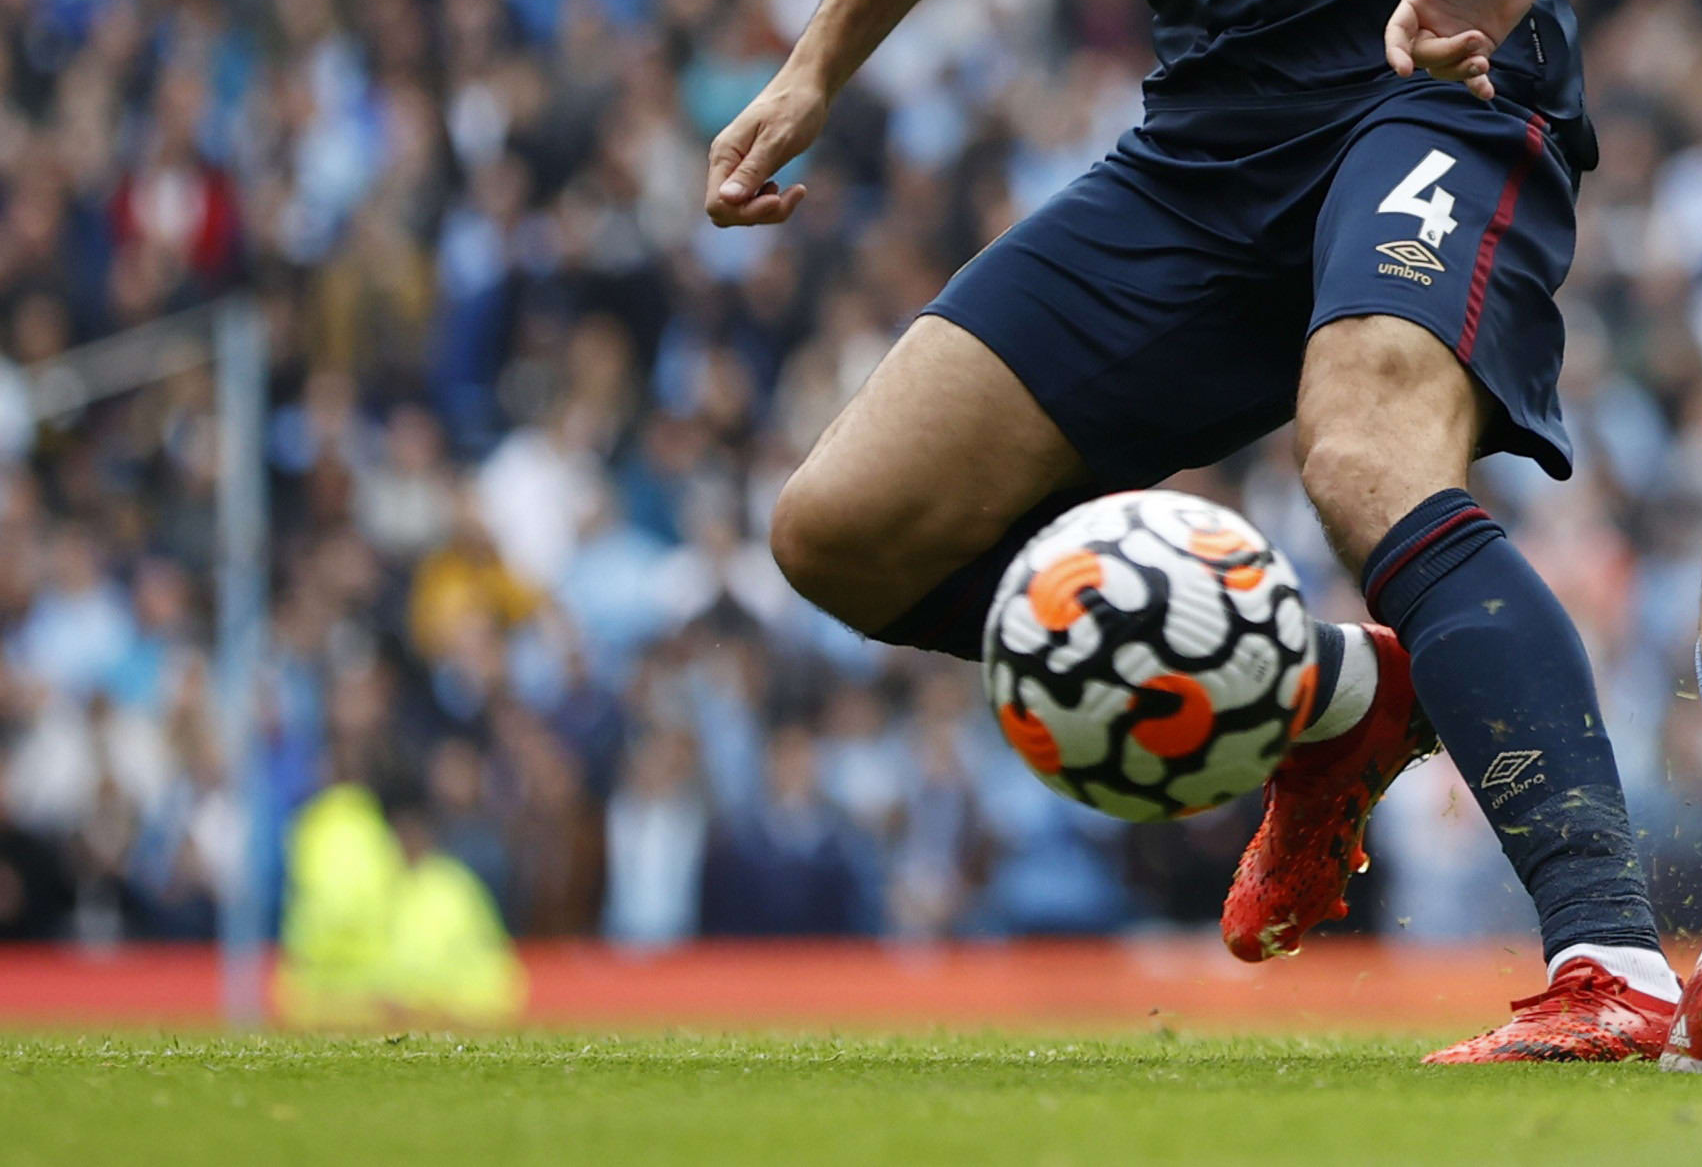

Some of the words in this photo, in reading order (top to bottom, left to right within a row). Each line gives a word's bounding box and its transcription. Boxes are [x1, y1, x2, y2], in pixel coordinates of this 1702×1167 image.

[1376, 148, 1459, 250] 4
[1377, 262, 1433, 286] umbro
[1491, 773, 1546, 810] umbro
